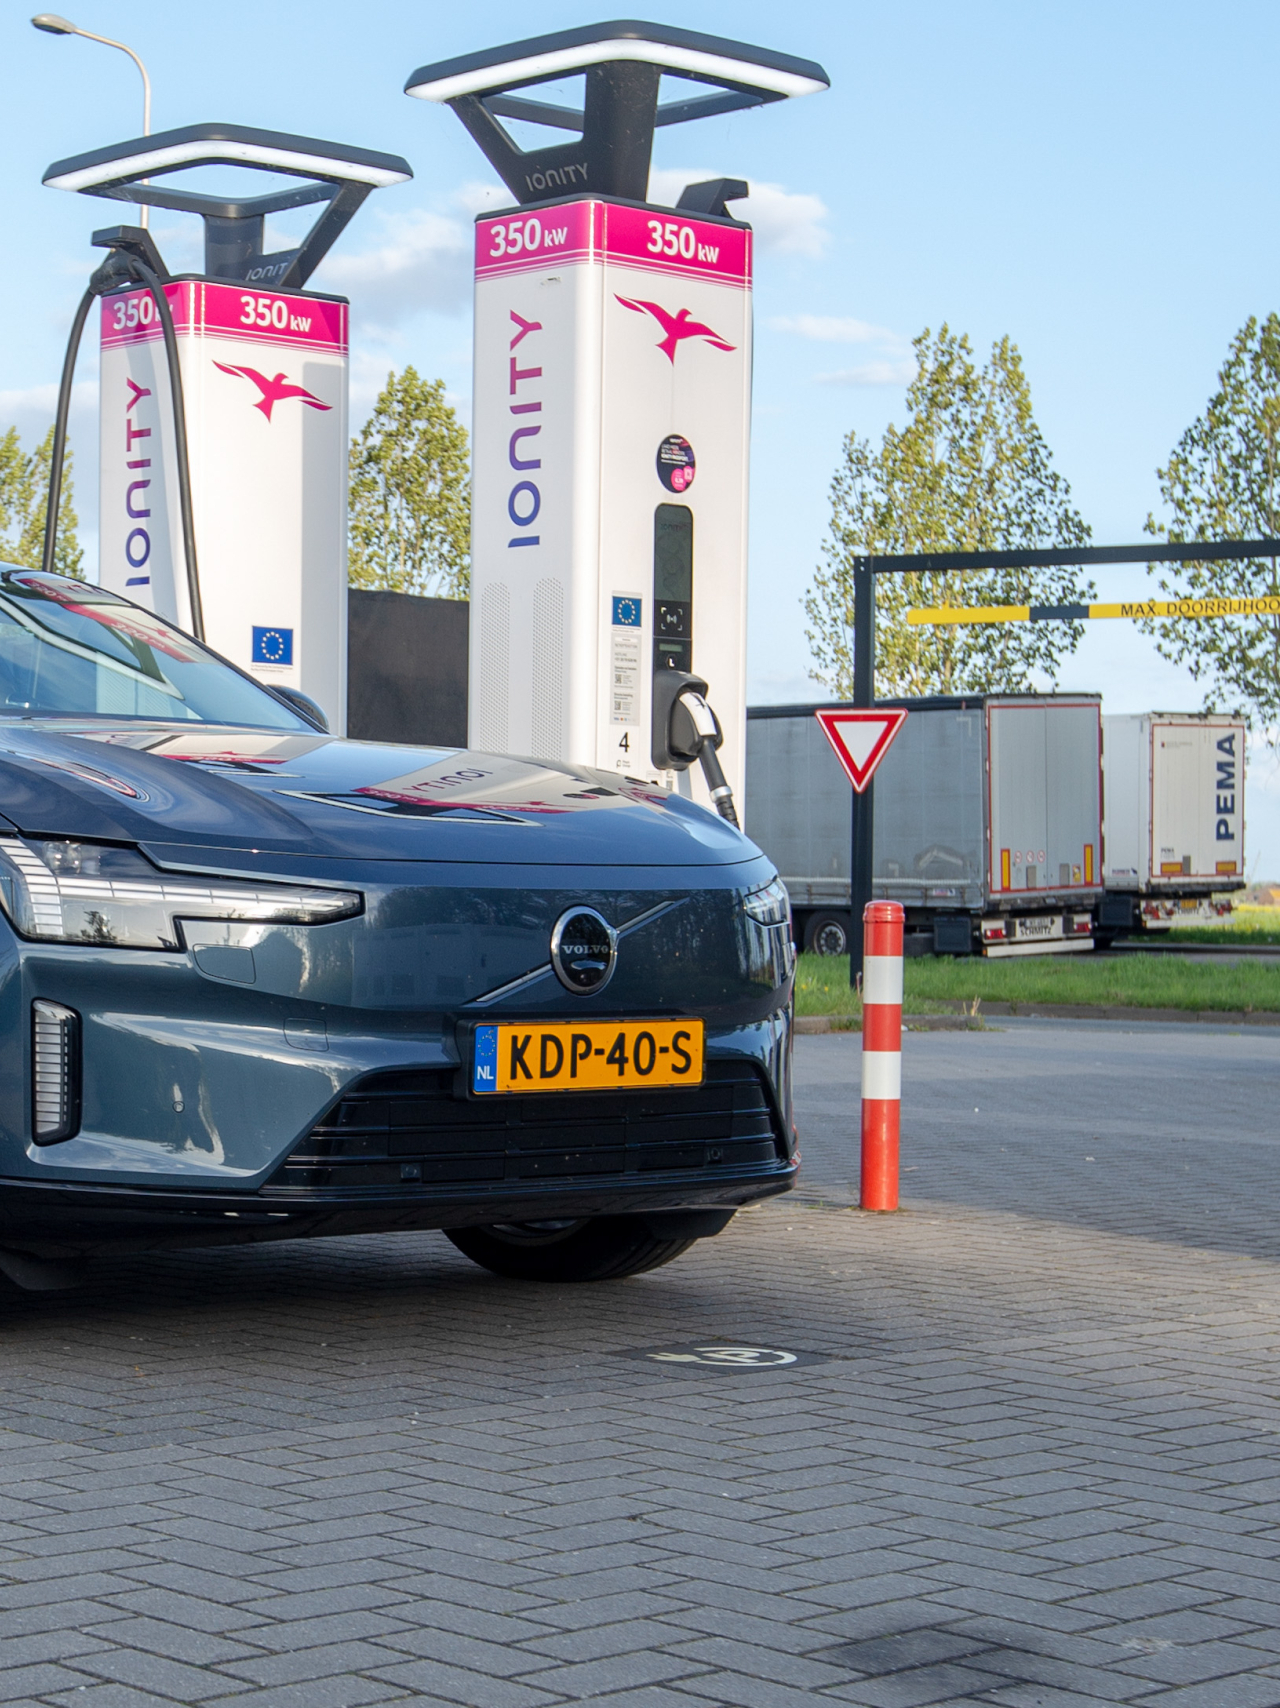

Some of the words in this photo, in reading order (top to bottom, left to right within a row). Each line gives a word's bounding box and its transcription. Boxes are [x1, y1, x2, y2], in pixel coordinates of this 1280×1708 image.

[526, 162, 589, 192] IONITY
[489, 218, 542, 257] 350
[544, 227, 568, 248] kW
[646, 220, 696, 259] 350
[698, 242, 719, 263] kW
[245, 262, 288, 281] IONIT
[113, 296, 153, 330] 350
[240, 295, 288, 329] 350
[290, 314, 312, 332] kW
[508, 310, 543, 548] IONITY
[125, 377, 151, 587] IONITY
[1121, 603, 1160, 616] MAX.
[1166, 598, 1280, 614] DOORRIJHOO
[619, 732, 630, 753] 4
[1216, 733, 1235, 841] PEMA
[561, 944, 610, 955] VOLVO
[509, 1030, 693, 1080] KDP-40-S
[476, 1065, 494, 1081] NL
